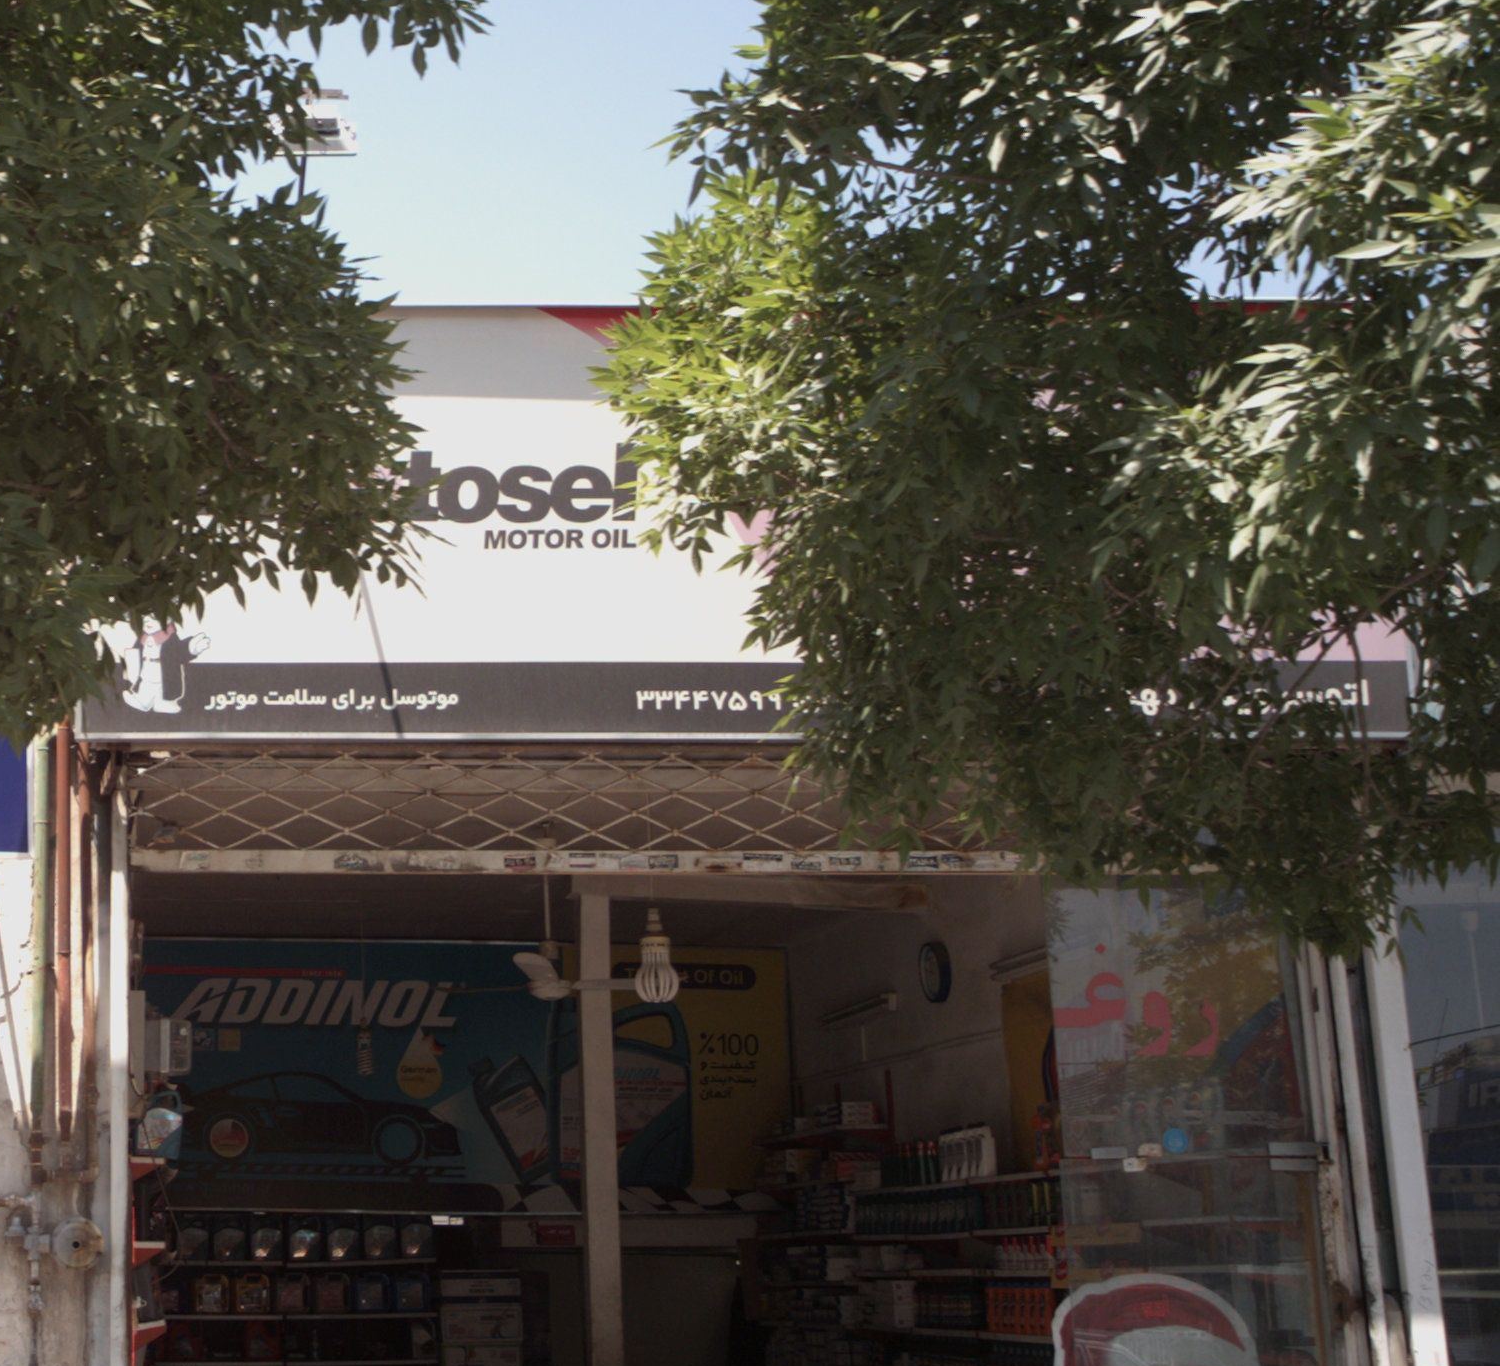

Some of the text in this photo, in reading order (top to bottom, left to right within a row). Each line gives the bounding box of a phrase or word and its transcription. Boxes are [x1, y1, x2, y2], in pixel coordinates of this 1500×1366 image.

[402, 442, 639, 524] tosel
[483, 529, 638, 549] MOTOR OIL
[204, 688, 459, 710] موتوسل برای سلامت موتور
[635, 689, 783, 711] ۳۳۴۴۷۵۹۹
[719, 969, 745, 985] Oil
[169, 977, 458, 1028] ADDINOL
